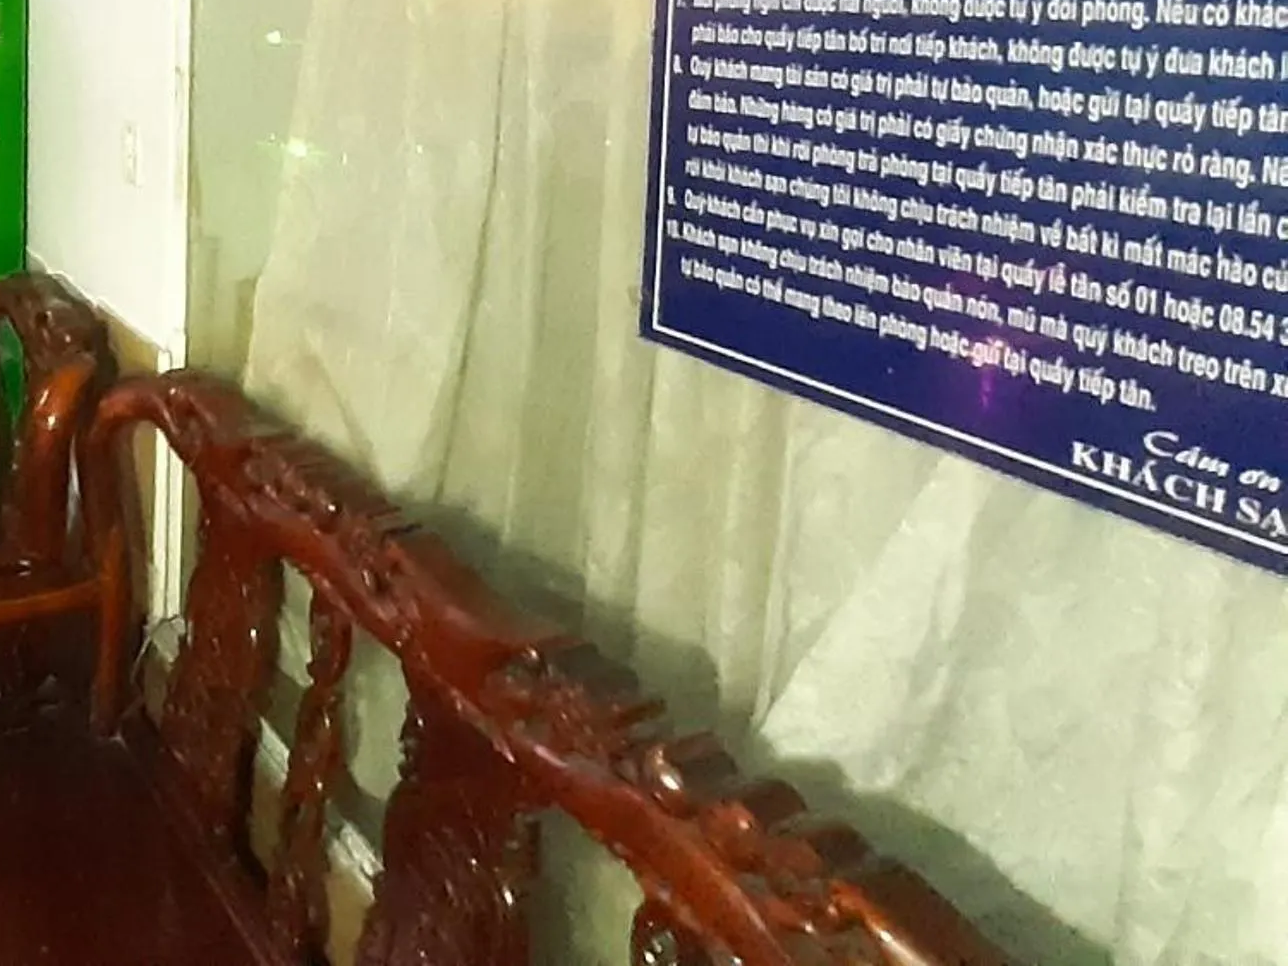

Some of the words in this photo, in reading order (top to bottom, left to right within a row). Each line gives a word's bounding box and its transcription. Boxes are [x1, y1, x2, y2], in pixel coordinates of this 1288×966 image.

[1007, 39, 1064, 72] không
[1068, 42, 1115, 73] được
[1164, 47, 1203, 75] đưa
[1208, 48, 1274, 79] khách
[1038, 85, 1084, 116] hoặc
[1155, 93, 1206, 132] quầy
[1212, 98, 1252, 136] tiếp
[1082, 136, 1118, 164] xác
[1122, 140, 1167, 173] thực
[1071, 182, 1114, 210] phải
[1118, 185, 1167, 219] kiểm
[1172, 197, 1201, 225] tra
[1206, 200, 1232, 234] lại
[1105, 280, 1132, 308] số
[1163, 292, 1213, 330] hoặc
[1219, 304, 1274, 341] 08.54
[1078, 367, 1114, 403] tiếp
[1113, 330, 1173, 366] khách
[1178, 346, 1219, 380] treo
[1224, 358, 1264, 391] trên
[1071, 441, 1227, 513] KHÁCH
